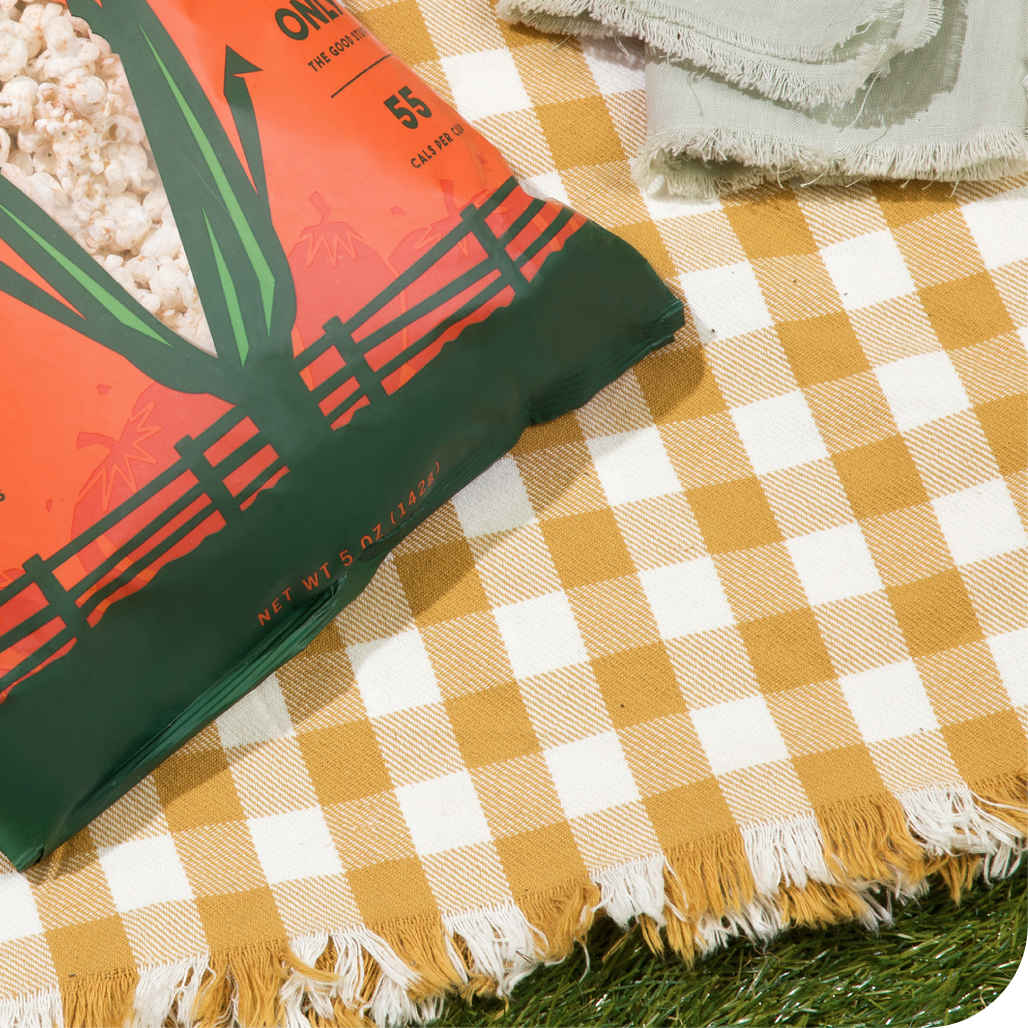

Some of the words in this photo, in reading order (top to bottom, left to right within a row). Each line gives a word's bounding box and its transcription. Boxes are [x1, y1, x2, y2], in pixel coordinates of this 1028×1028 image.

[307, 52, 331, 72] THE
[328, 35, 354, 56] GOOD
[383, 86, 432, 129] 55
[410, 145, 437, 169] CALS
[434, 132, 454, 150] PER
[257, 587, 292, 626] NET
[302, 562, 331, 591] WT
[339, 549, 353, 566] 5
[360, 524, 385, 549] OZ
